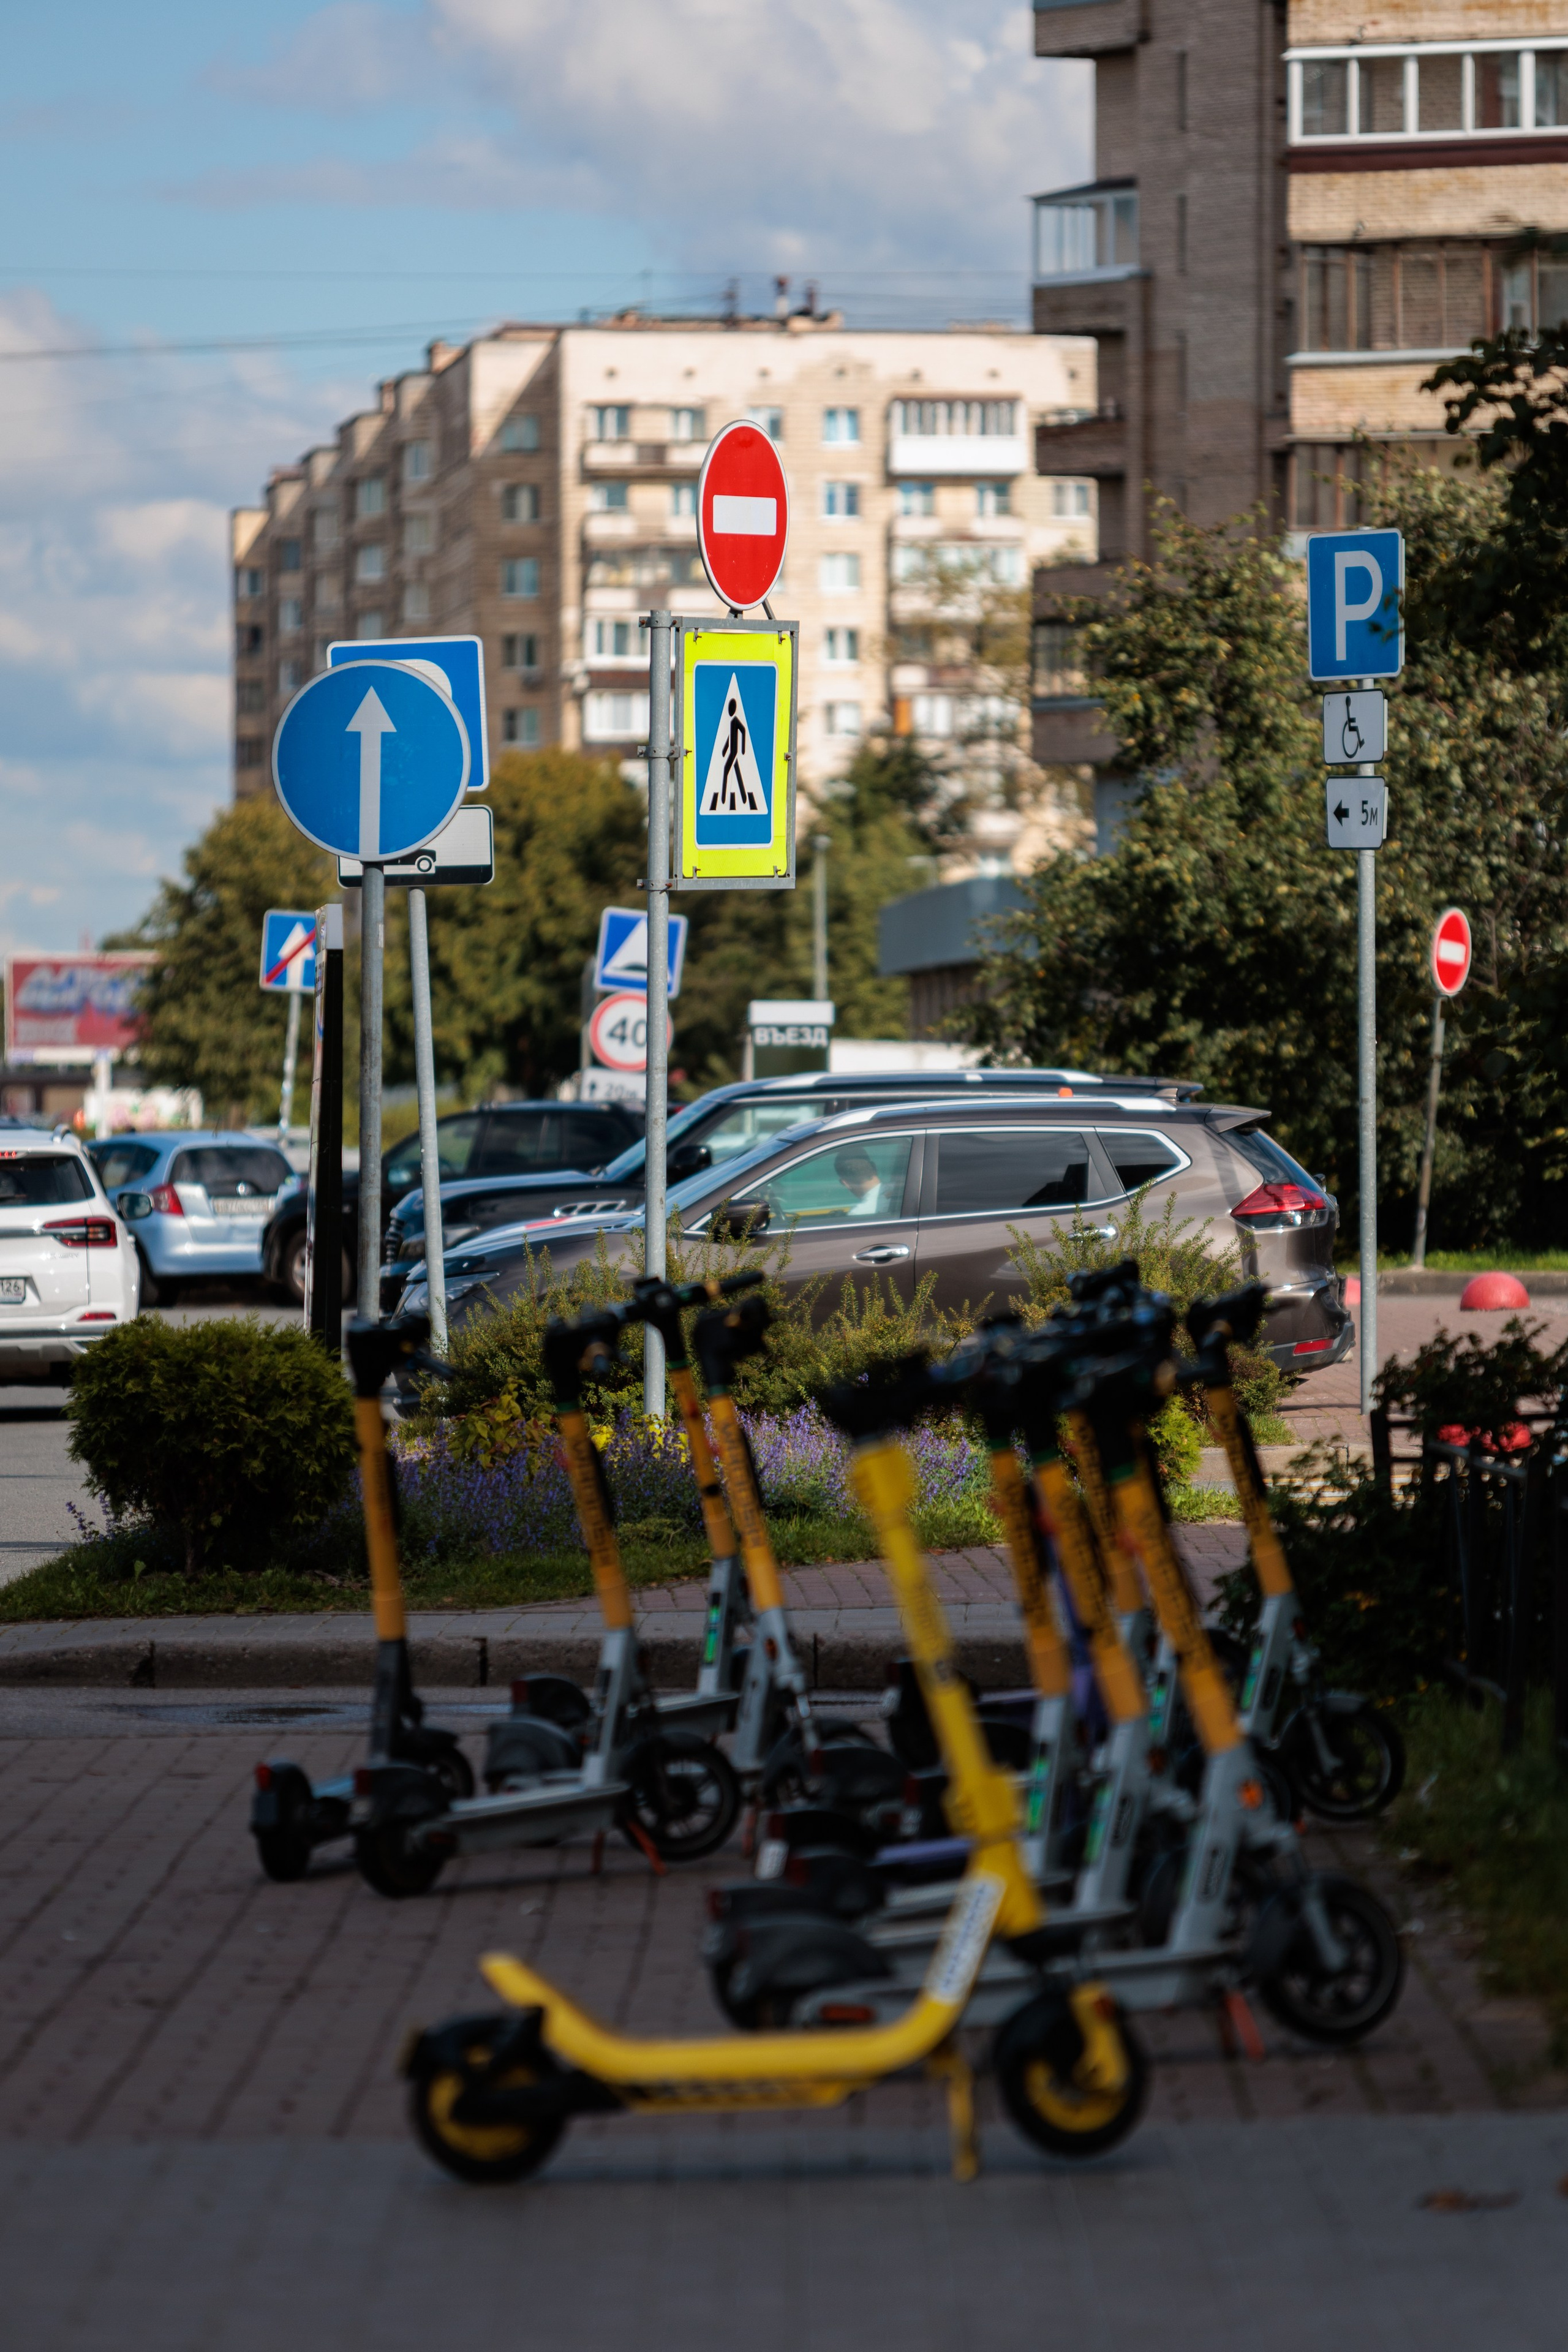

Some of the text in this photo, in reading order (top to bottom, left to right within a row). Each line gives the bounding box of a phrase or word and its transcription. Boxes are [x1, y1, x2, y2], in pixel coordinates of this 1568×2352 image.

[1334, 550, 1383, 661] P
[606, 1016, 647, 1048] 40
[754, 1027, 829, 1048] ВЪЕЗД
